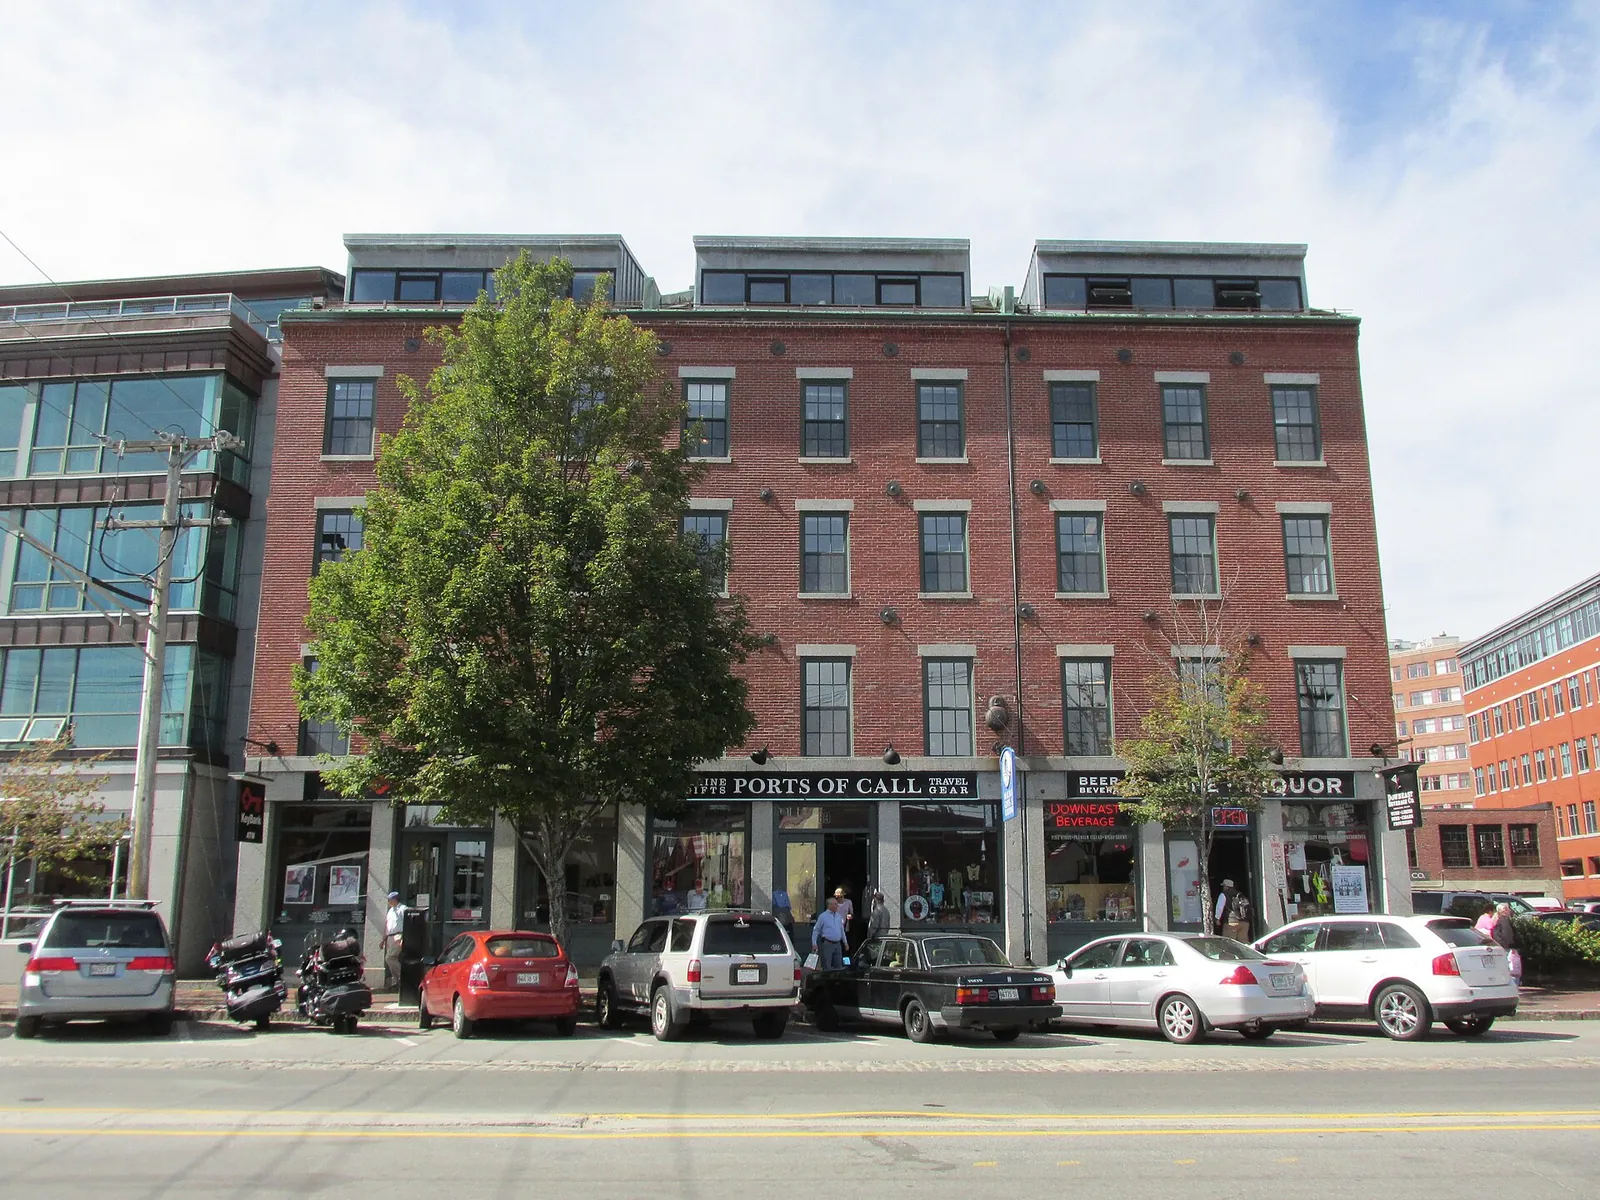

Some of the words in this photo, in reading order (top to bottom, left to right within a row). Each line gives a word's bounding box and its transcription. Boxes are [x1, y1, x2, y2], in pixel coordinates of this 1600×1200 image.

[733, 778, 811, 794] PORTS
[817, 778, 849, 794] OF
[856, 778, 922, 794] CALL
[928, 777, 969, 786] TRAVEL
[928, 786, 969, 794] GEAR
[1050, 803, 1119, 815] DOWNEAST
[1056, 816, 1115, 827] BEVERAGE
[1214, 809, 1246, 824] OPEN
